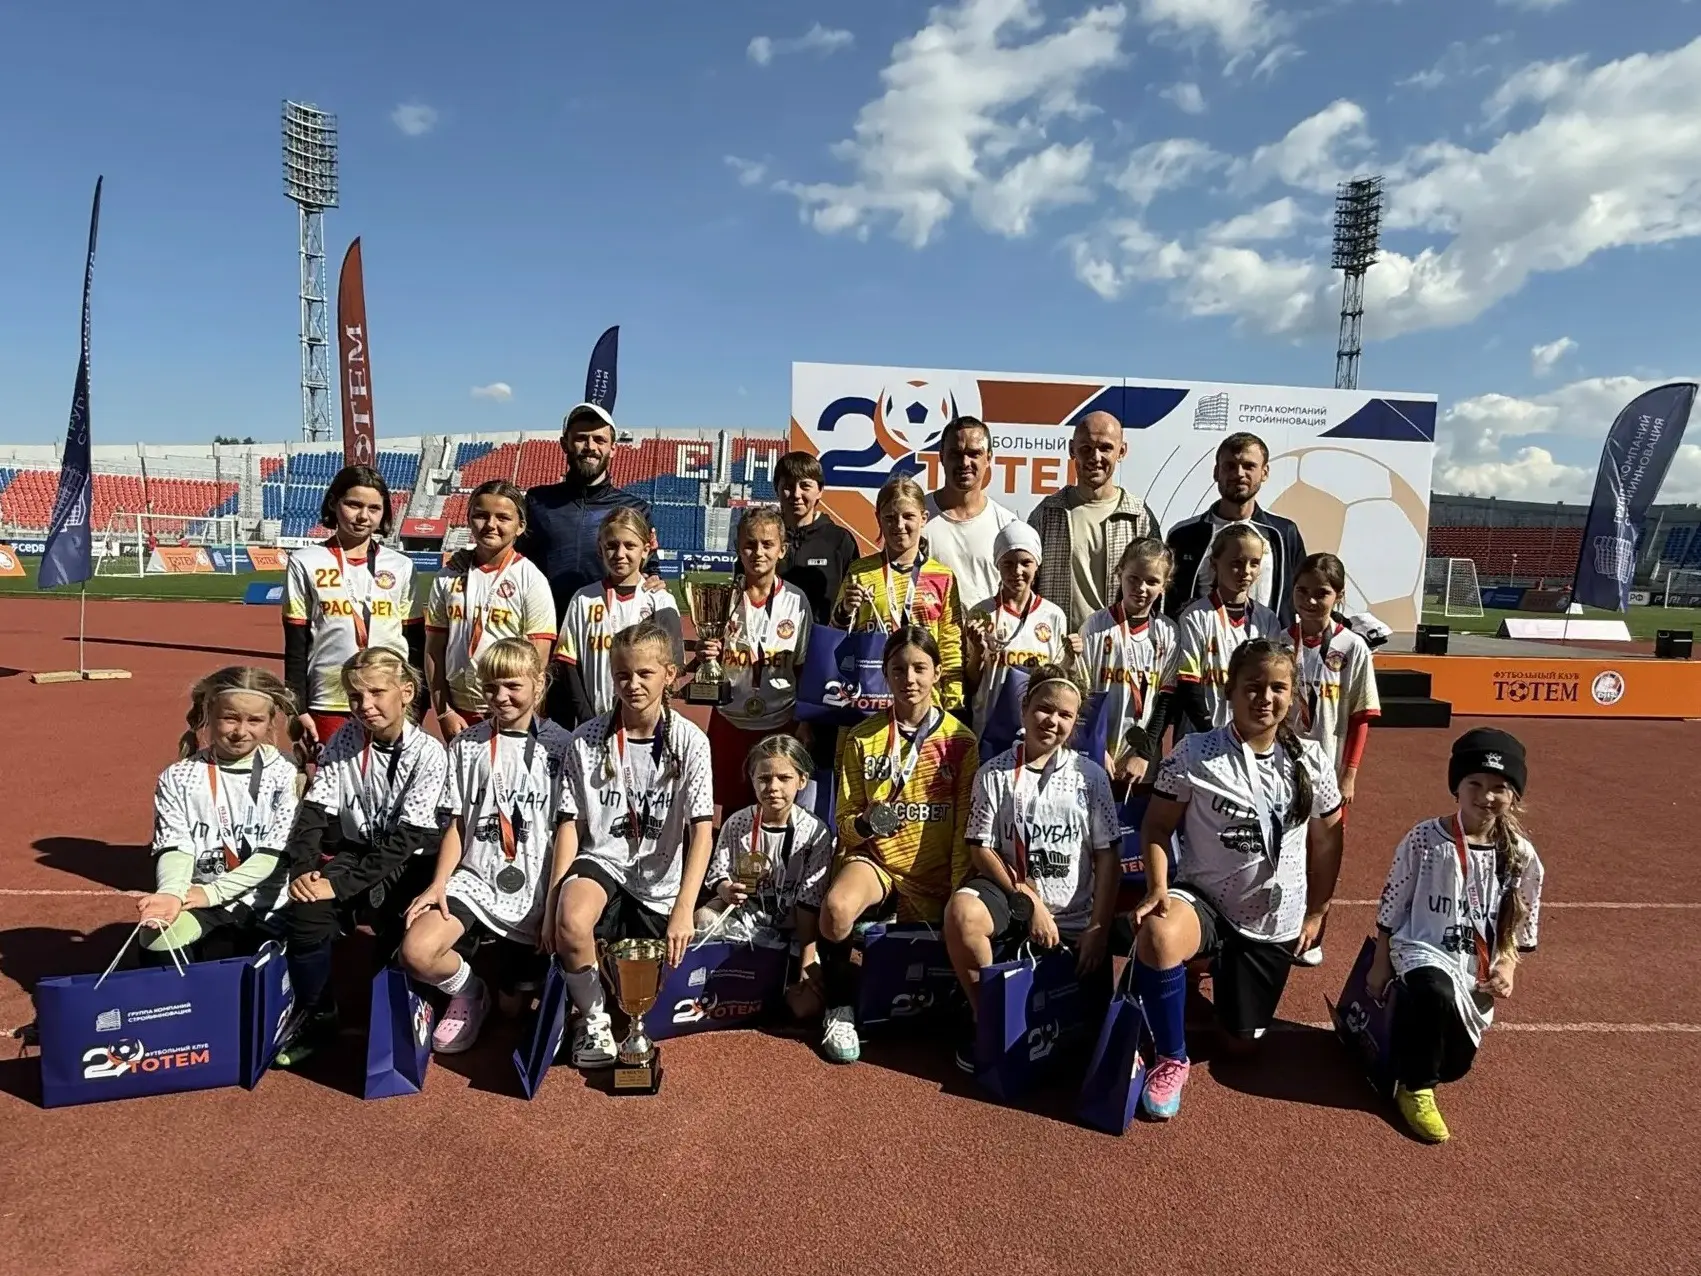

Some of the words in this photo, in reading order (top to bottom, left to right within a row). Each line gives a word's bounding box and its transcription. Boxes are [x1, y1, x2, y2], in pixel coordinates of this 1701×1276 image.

[1239, 404, 1273, 413] ГРУППА
[1274, 406, 1327, 415] КОМПАНИЙ
[1238, 414, 1327, 426] СТРОЙИННОВАЦИЯ
[991, 434, 1067, 451] БОЛЬНЫЙ
[1619, 413, 1652, 481] КОМПАНИЙ
[916, 452, 1077, 494] ТТЕ
[315, 568, 341, 588] 22
[321, 600, 392, 616] РАСВЕТ
[588, 604, 604, 622] 18
[1493, 671, 1557, 680] ФУТБОЛЬНЫЙ
[1557, 672, 1580, 680] КЛУБ
[1493, 681, 1579, 702] ТОТЕМ
[599, 788, 622, 809] ИП
[894, 802, 950, 822] ССВЕТ
[1428, 895, 1452, 917] ИП
[129, 1050, 210, 1073] ТОТЕМ
[145, 1046, 191, 1057] ФУТБОЛЬНЫЙ
